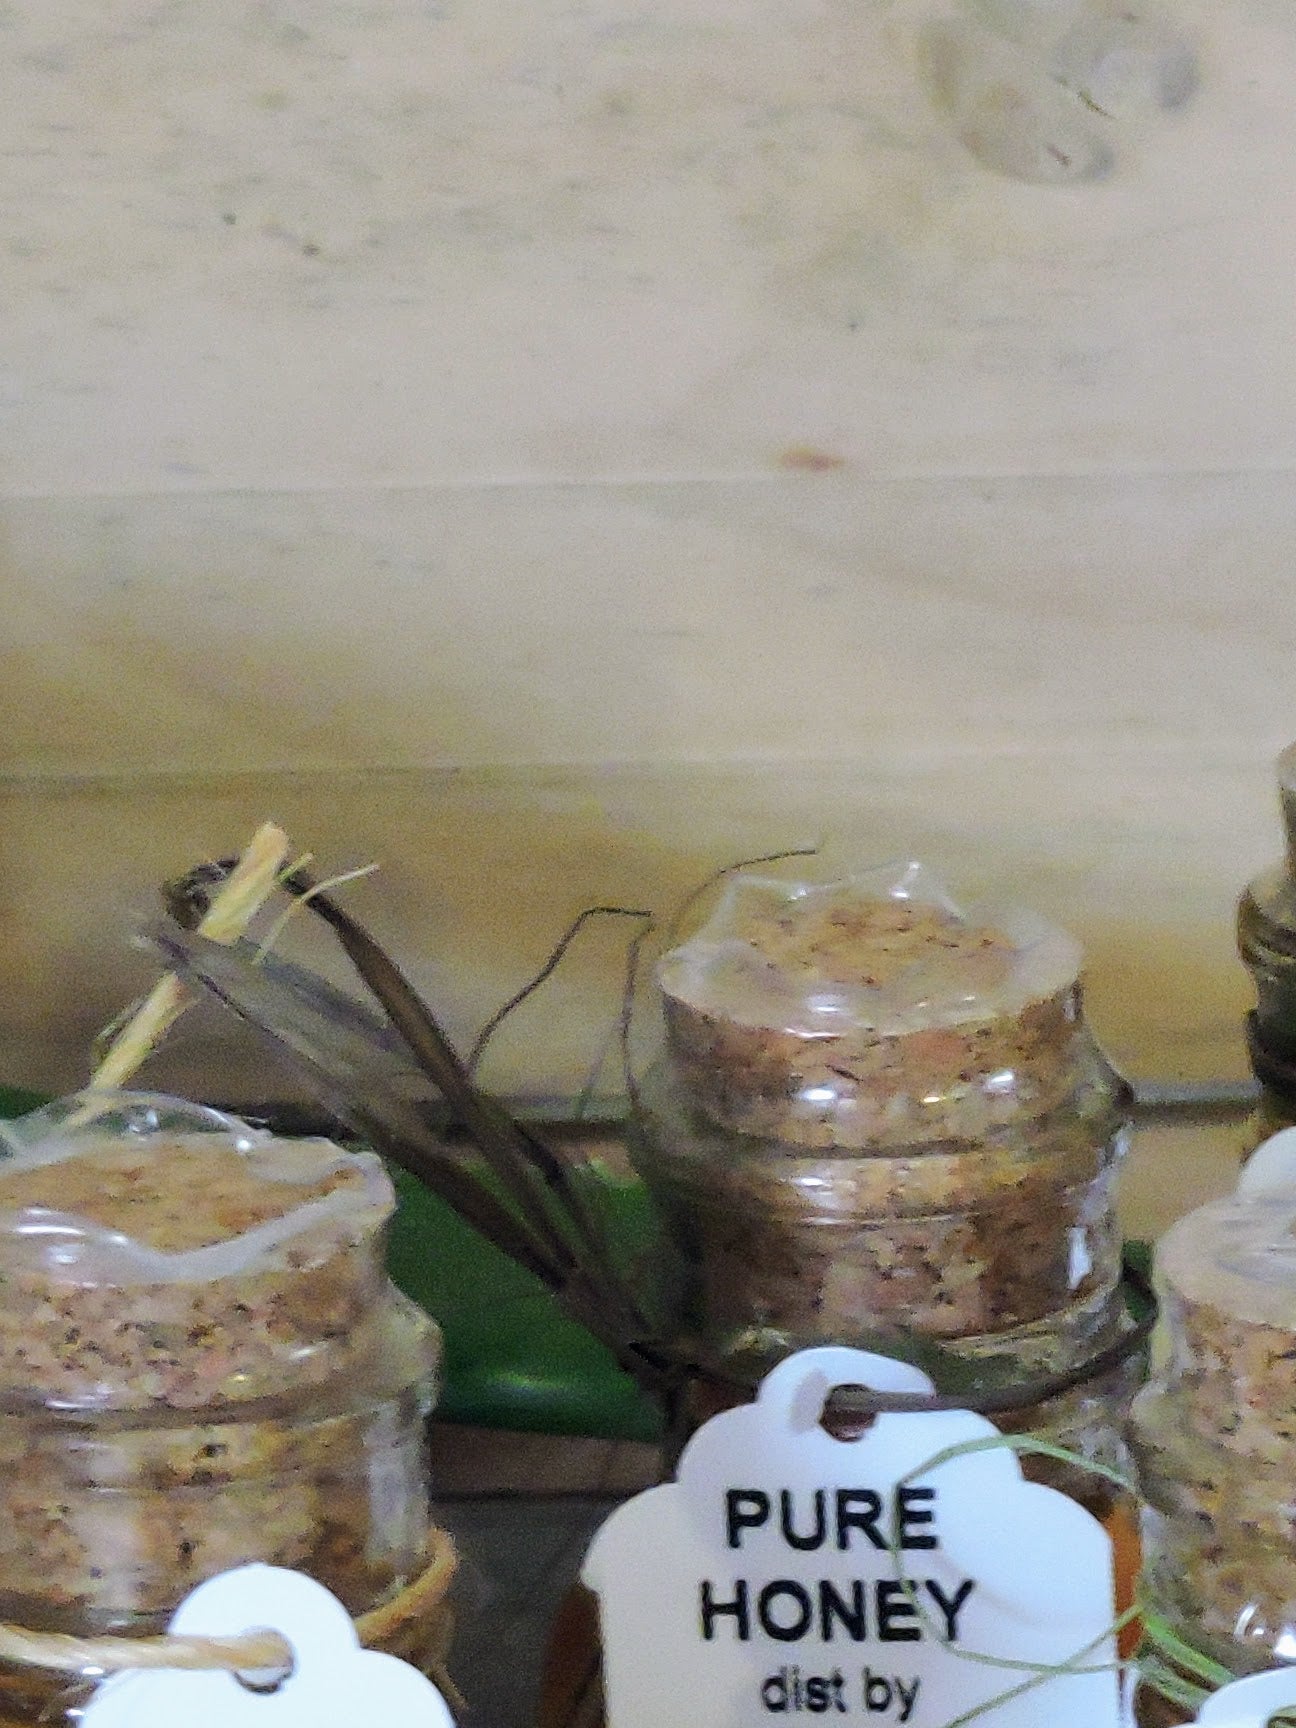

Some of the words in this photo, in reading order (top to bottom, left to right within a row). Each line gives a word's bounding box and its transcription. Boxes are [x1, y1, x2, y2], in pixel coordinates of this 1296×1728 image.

[726, 1482, 940, 1553] PURE
[701, 1579, 976, 1644] HONEY
[761, 1668, 848, 1715] dist
[864, 1667, 921, 1725] by
